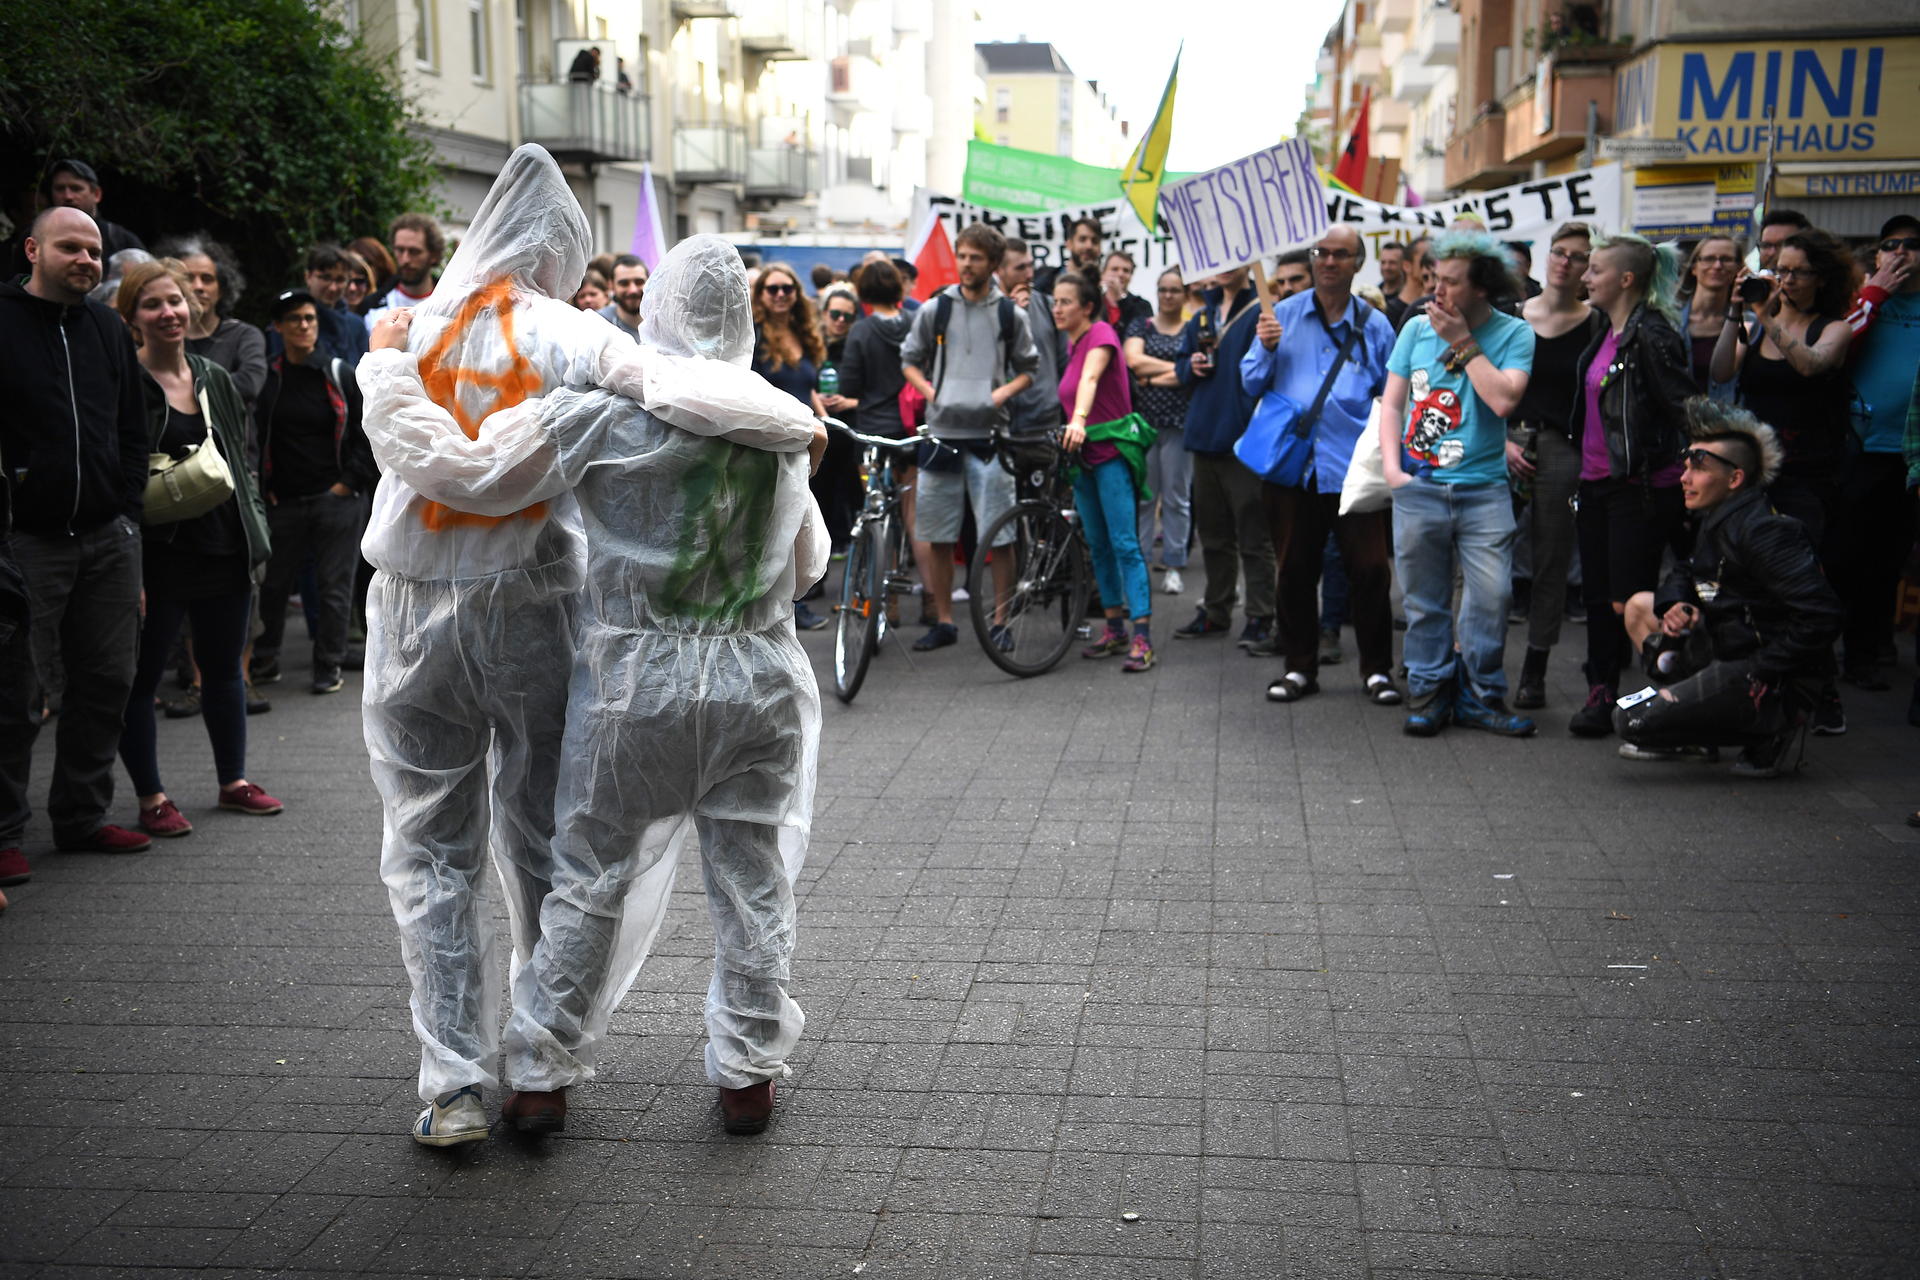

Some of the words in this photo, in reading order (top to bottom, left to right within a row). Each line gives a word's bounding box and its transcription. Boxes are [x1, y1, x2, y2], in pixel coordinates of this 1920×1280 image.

[1678, 47, 1885, 120] MINI
[1677, 122, 1876, 154] KAUFHAUS
[1160, 137, 1328, 273] MIETSTREIK
